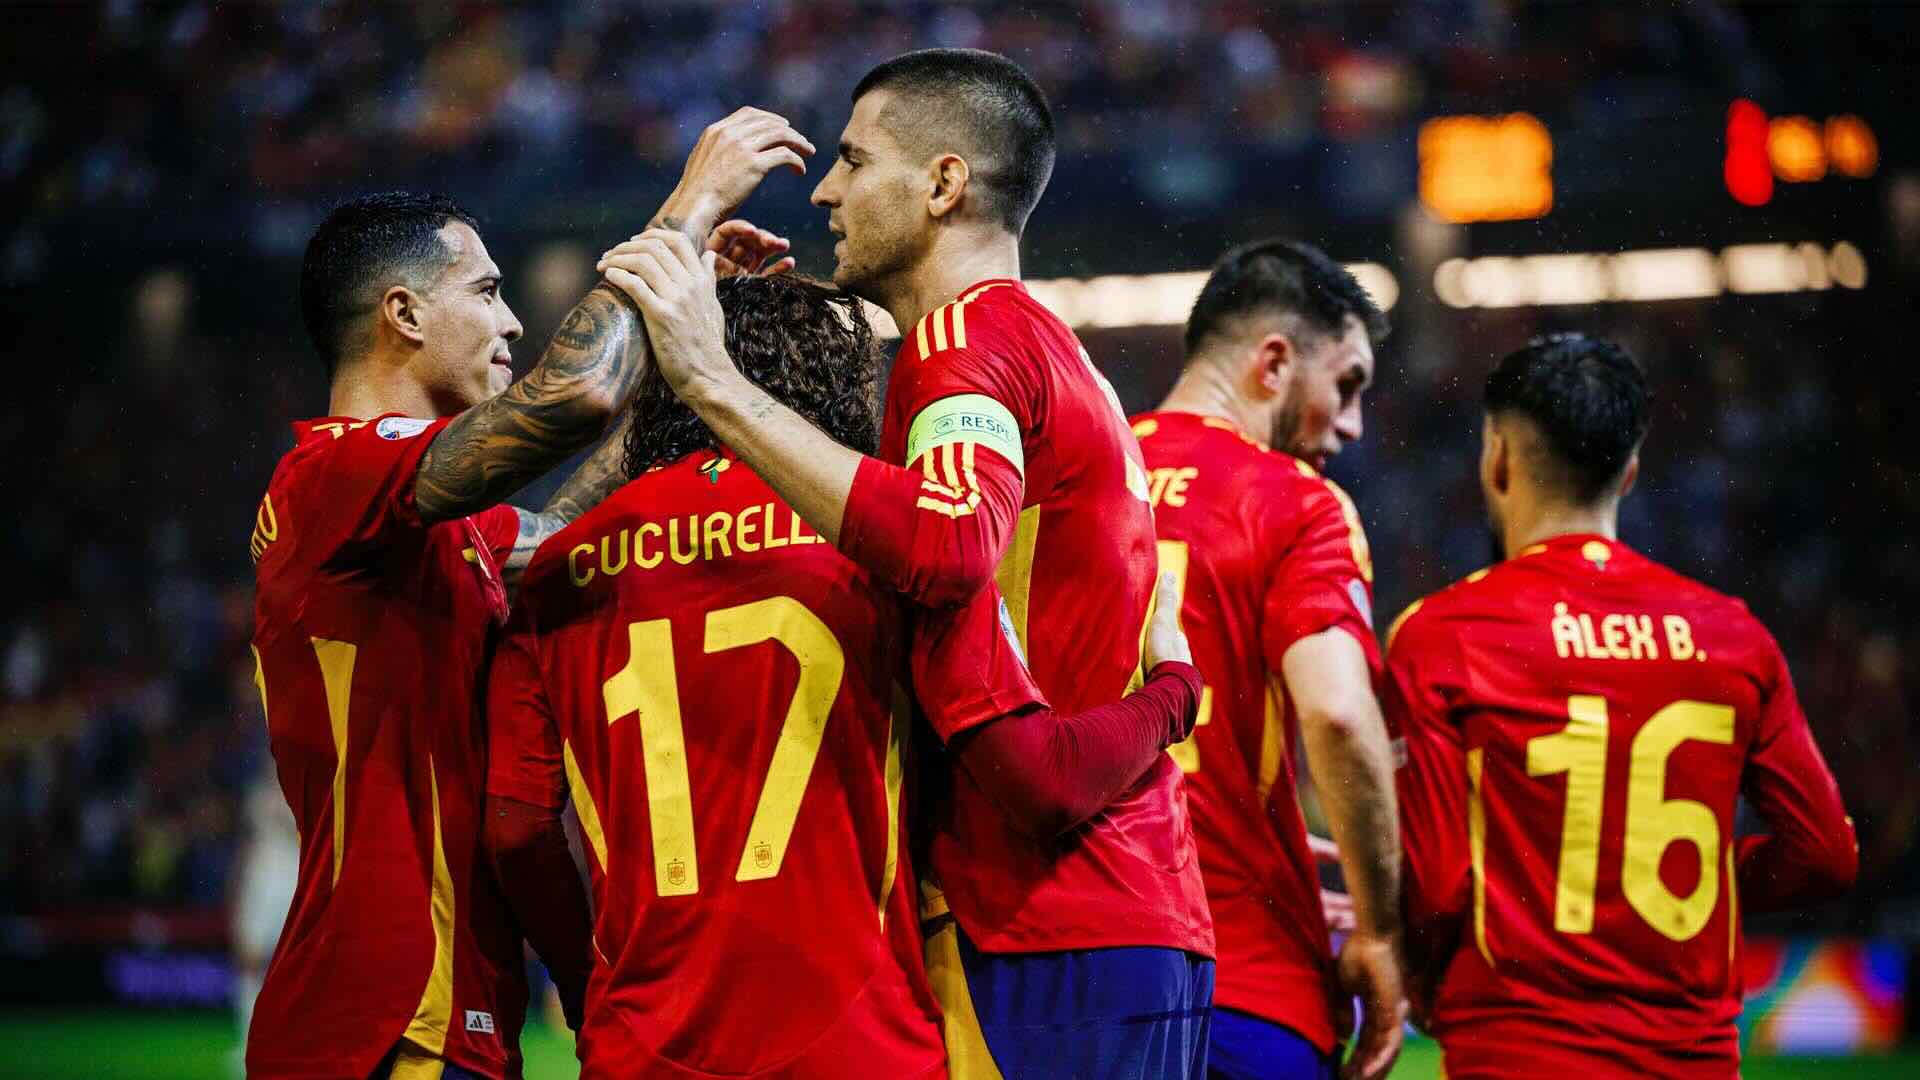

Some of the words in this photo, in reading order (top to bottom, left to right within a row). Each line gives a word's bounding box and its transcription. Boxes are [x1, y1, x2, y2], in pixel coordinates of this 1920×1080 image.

[1145, 467, 1199, 508] TE
[568, 502, 827, 588] CUCURELL
[1663, 615, 1708, 662] B.
[602, 595, 846, 897] 17
[1525, 694, 1737, 942] 16
